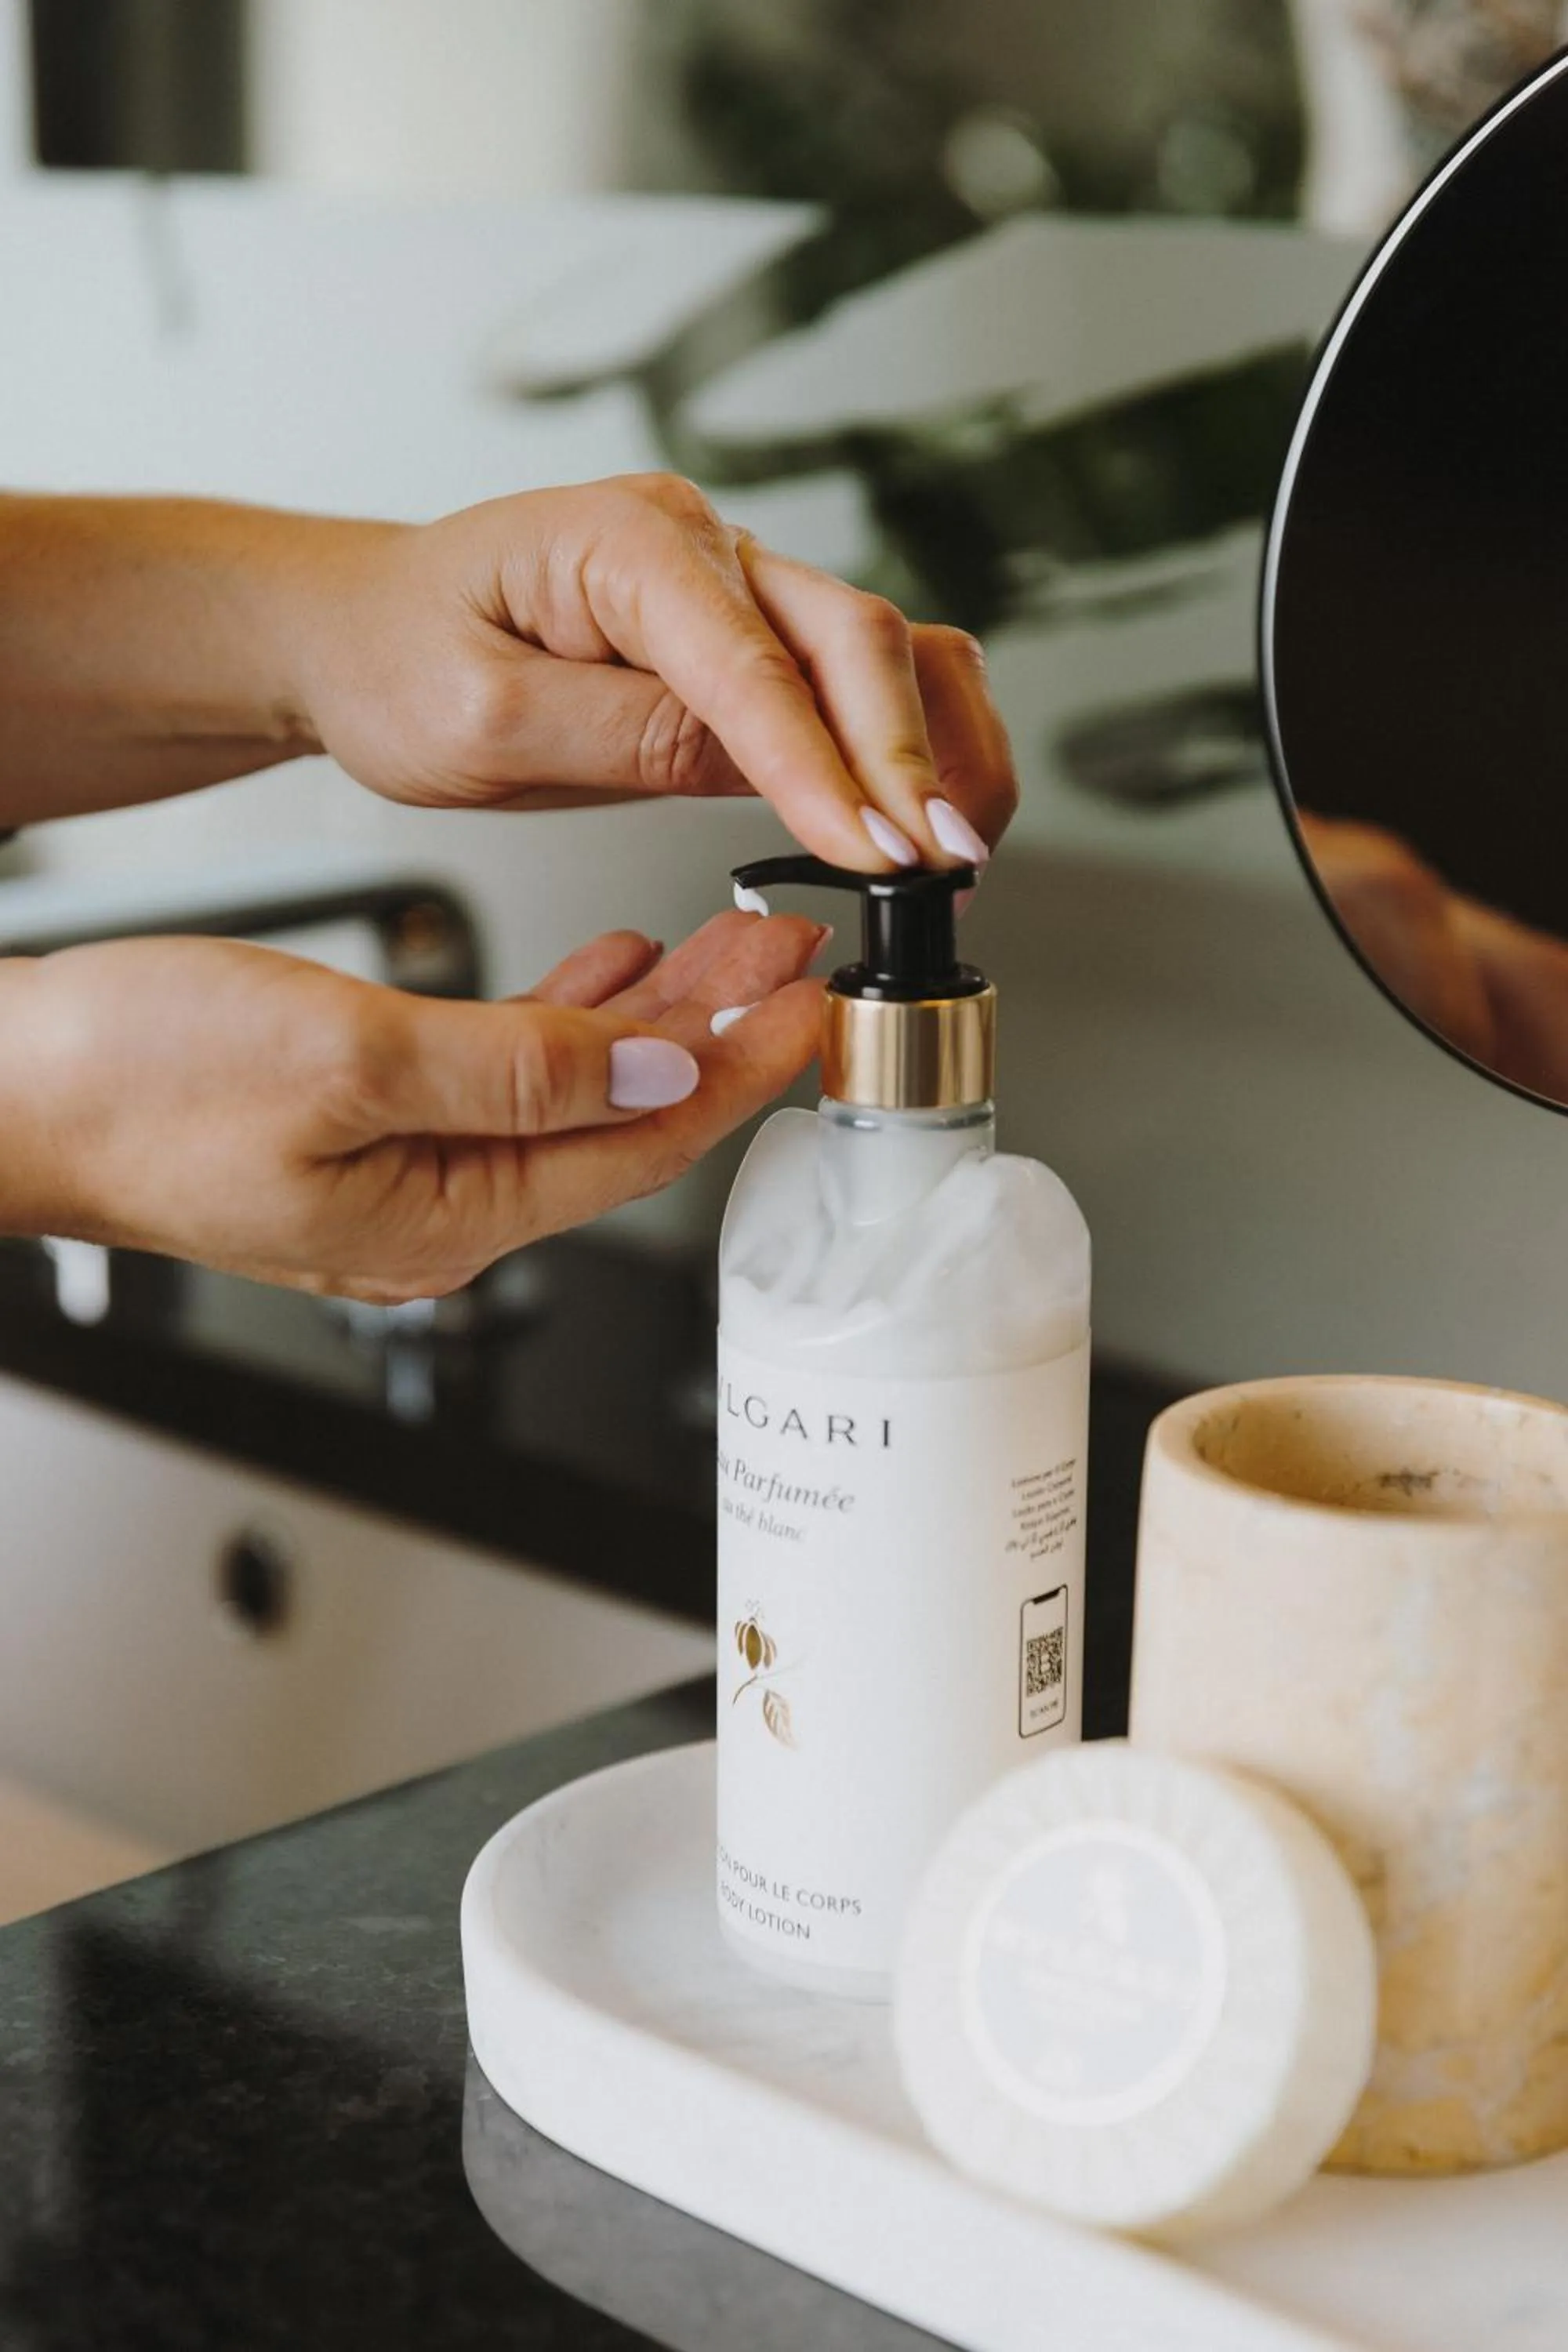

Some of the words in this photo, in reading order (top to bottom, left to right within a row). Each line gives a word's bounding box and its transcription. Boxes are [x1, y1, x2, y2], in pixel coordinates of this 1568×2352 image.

[733, 1458, 855, 1513] Parfumée
[757, 1510, 805, 1541] blanc
[732, 1860, 768, 1894] POUR
[772, 1881, 790, 1903] LE
[796, 1889, 862, 1916] CORPS
[748, 1904, 811, 1940] LOTION
